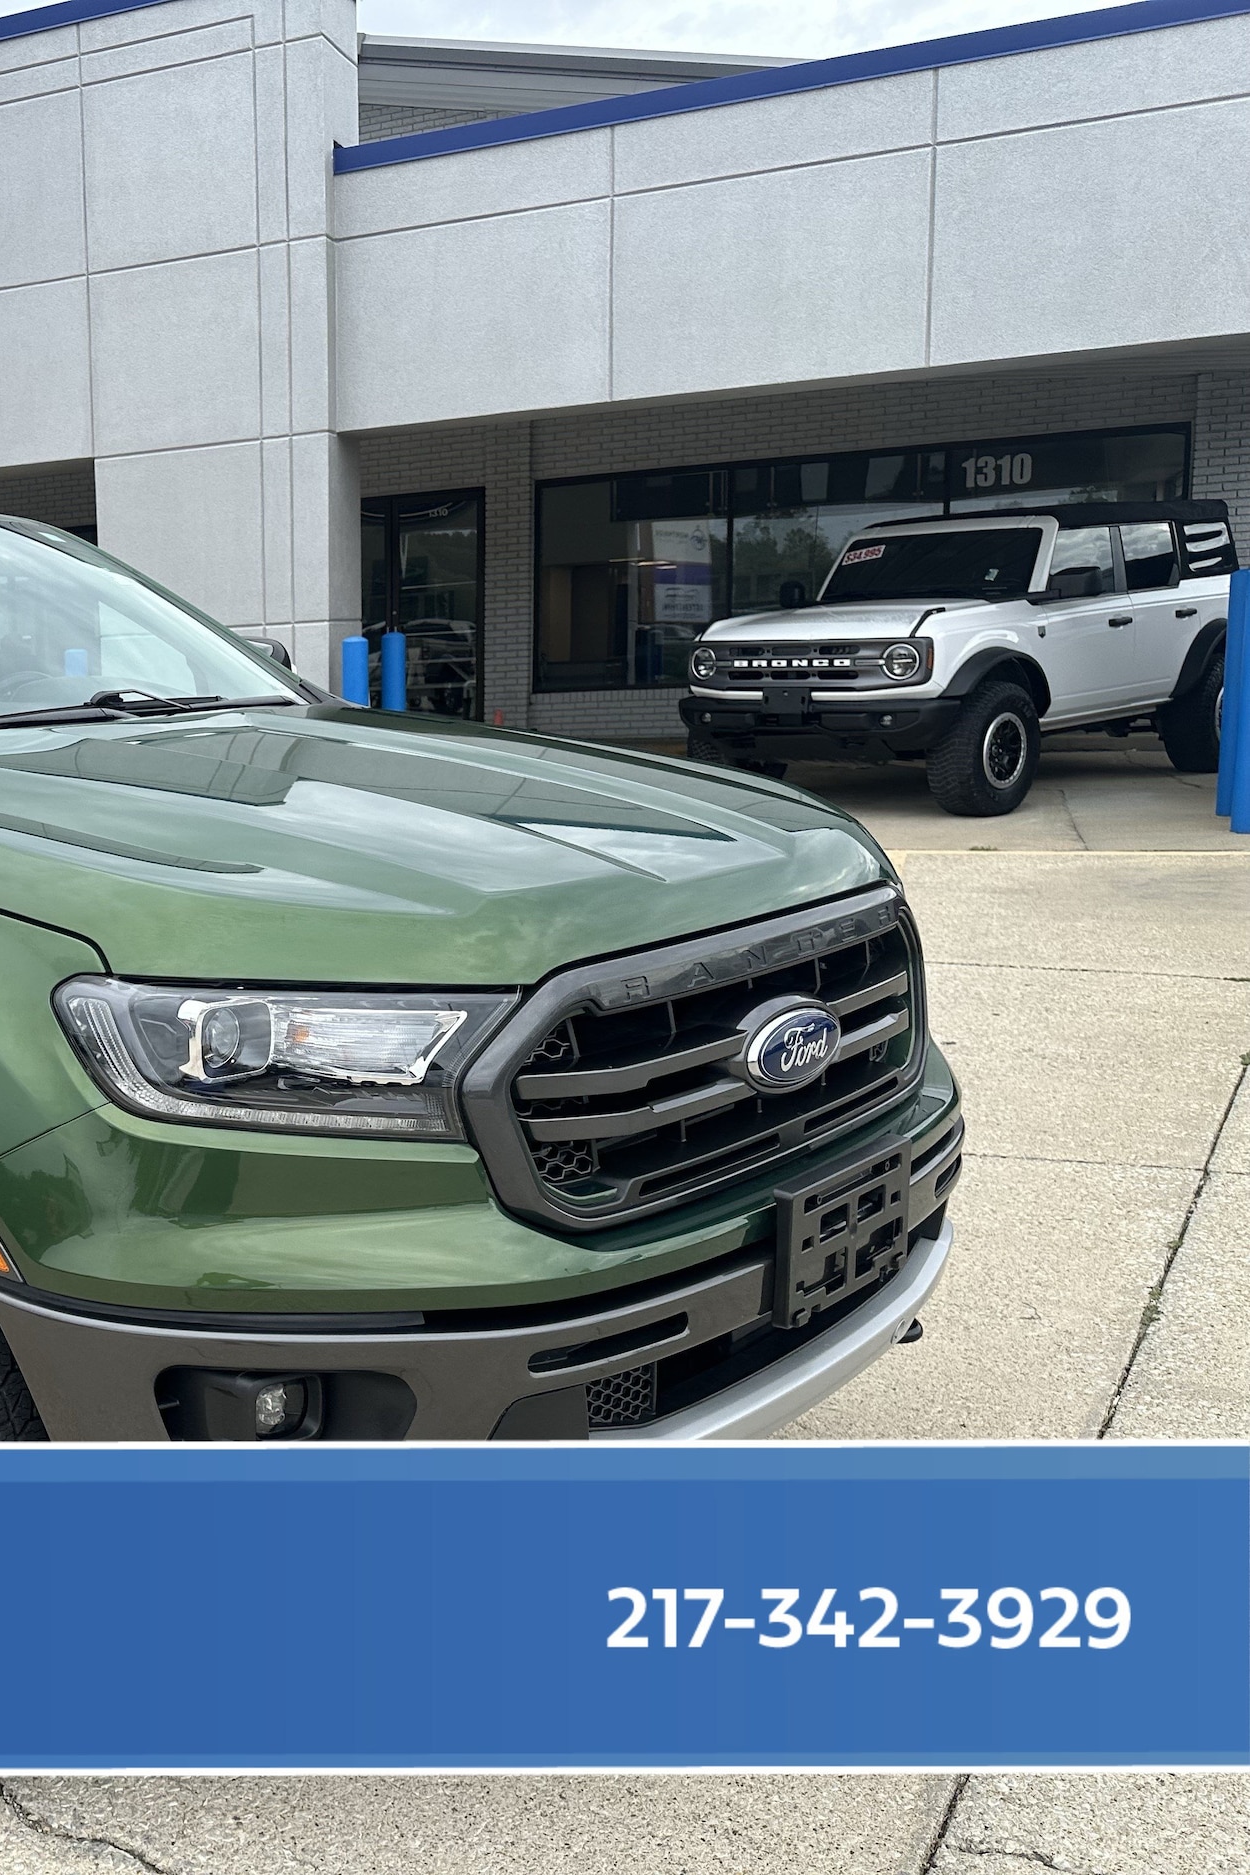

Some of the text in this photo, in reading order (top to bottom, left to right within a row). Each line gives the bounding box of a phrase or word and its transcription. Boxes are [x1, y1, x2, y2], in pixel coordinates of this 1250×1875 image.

[961, 452, 1033, 488] 1310
[733, 659, 851, 668] BRONCO
[620, 905, 893, 1001] RANGER
[781, 1022, 829, 1072] Ford
